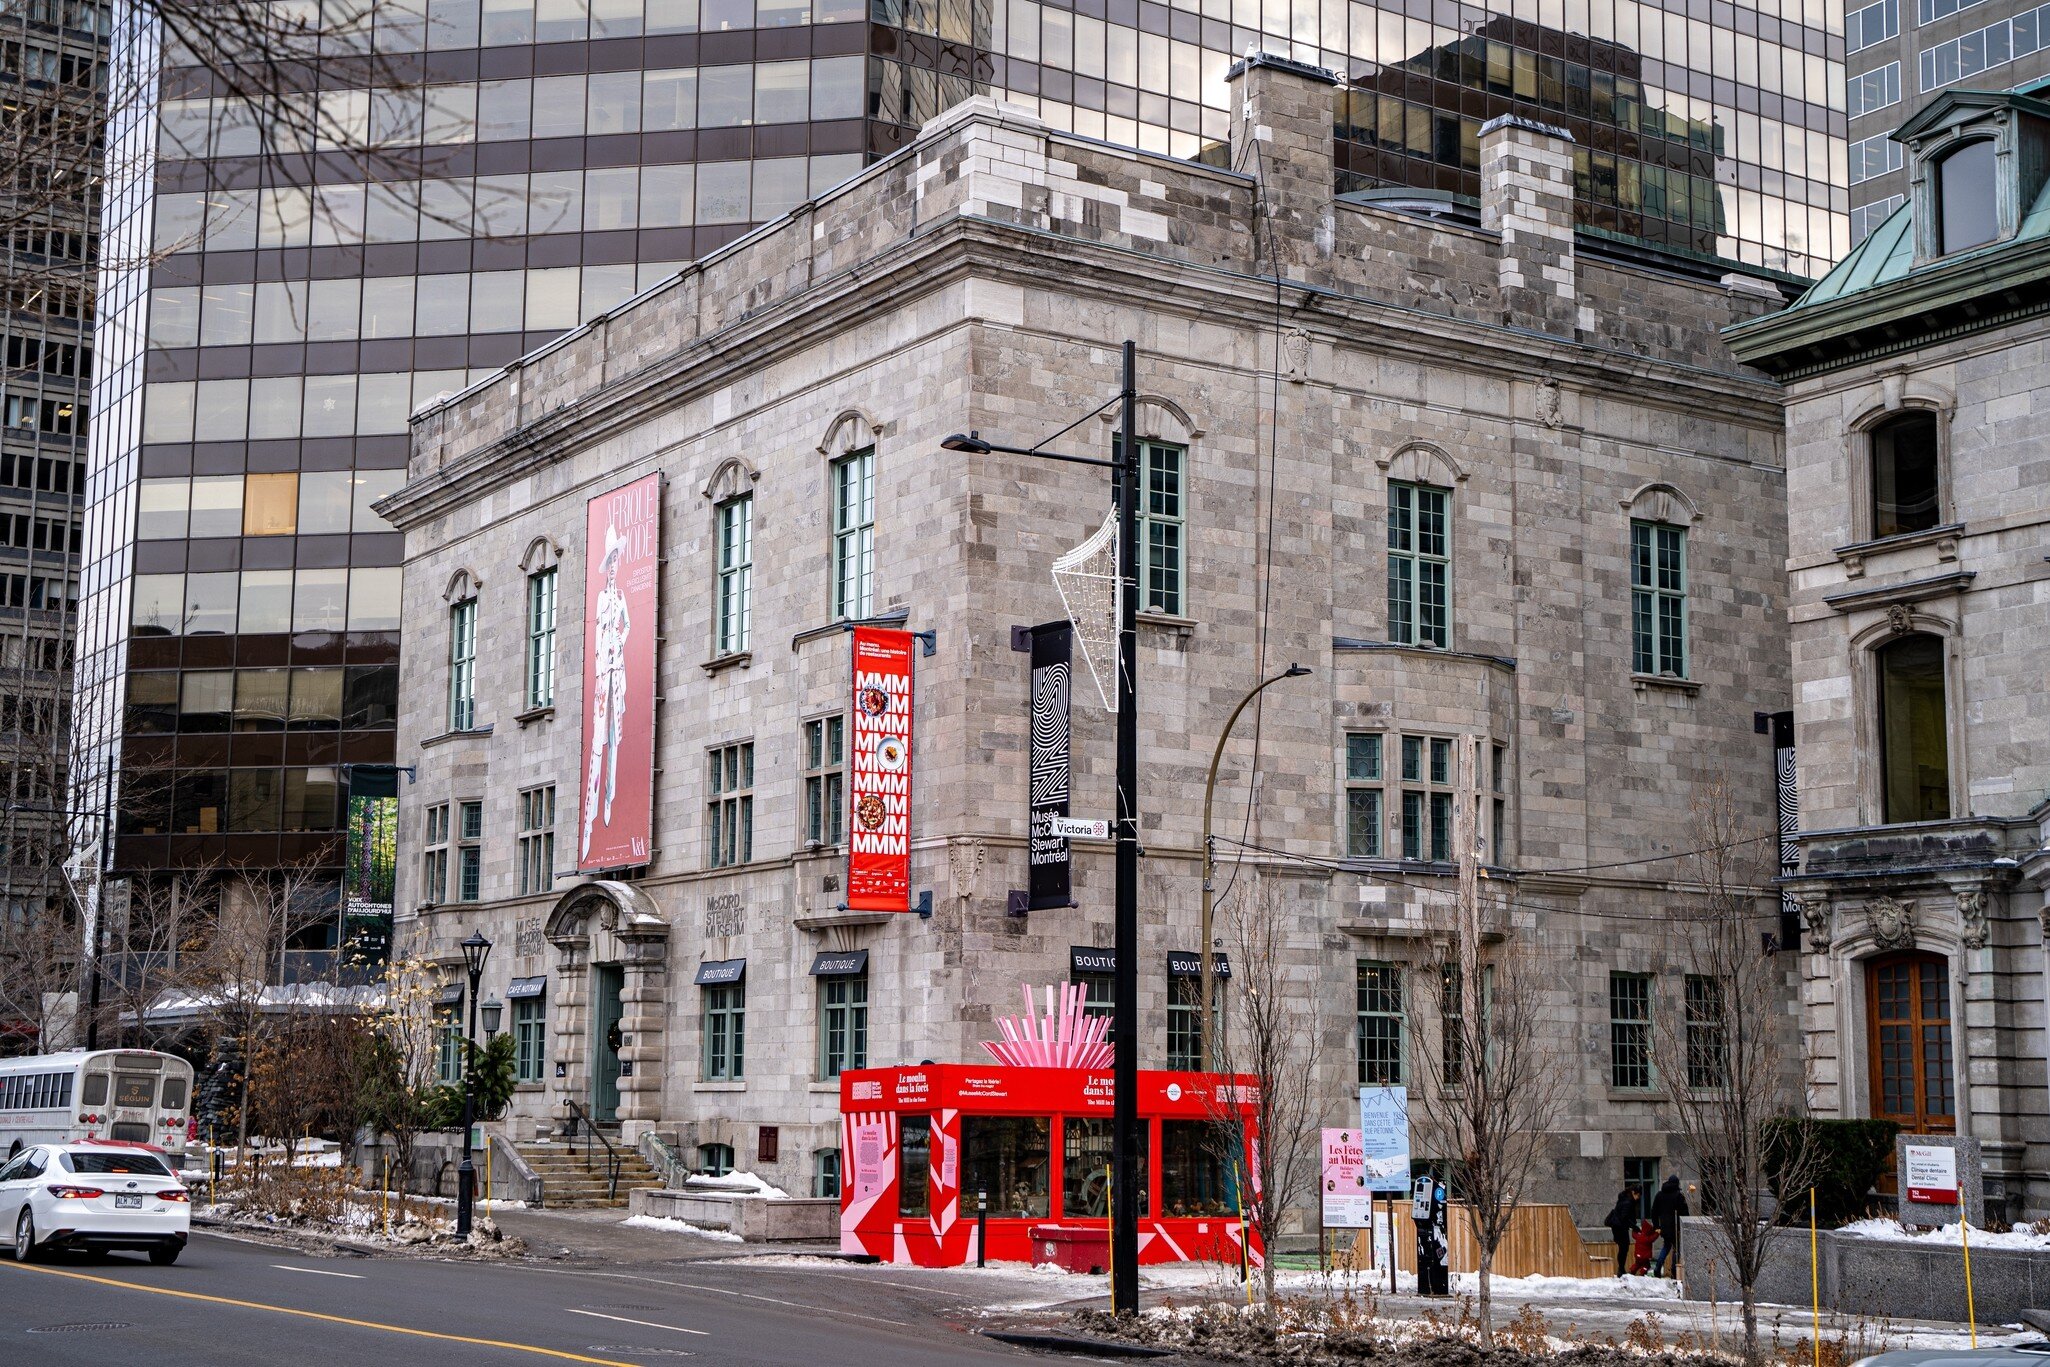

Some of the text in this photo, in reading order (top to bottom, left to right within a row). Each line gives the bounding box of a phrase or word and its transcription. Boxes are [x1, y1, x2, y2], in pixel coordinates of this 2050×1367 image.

[604, 482, 654, 536] AFRIQUE
[619, 520, 653, 566] MODE
[890, 648, 906, 656] histoire
[855, 711, 909, 735] MMM
[854, 771, 908, 795] MMM
[1031, 808, 1060, 824] Musée
[1057, 823, 1092, 835] Victoria
[852, 833, 907, 856] MMM
[1031, 836, 1064, 852] Stewart
[1031, 848, 1068, 866] Montréal
[706, 907, 745, 926] STEWART
[705, 922, 745, 939] MUSEUM
[819, 959, 856, 970] BOUTIQUE
[1075, 955, 1116, 968] BOUTI
[1172, 960, 1230, 973] BOUTUE
[703, 968, 735, 979] BOUTIQUE
[507, 984, 541, 995] CAFÉ NOTMAN
[899, 1072, 926, 1083] Le moulin
[1088, 1075, 1098, 1086] Le
[896, 1082, 929, 1094] dans la forêt
[1084, 1085, 1114, 1096] dans la
[1364, 1111, 1389, 1119] BIENVENUE
[1365, 1119, 1391, 1127] DANS CETTE
[1365, 1127, 1373, 1135] RUE
[1329, 1145, 1342, 1155] Les
[1344, 1145, 1364, 1155] Fêtes
[1328, 1156, 1339, 1165] au
